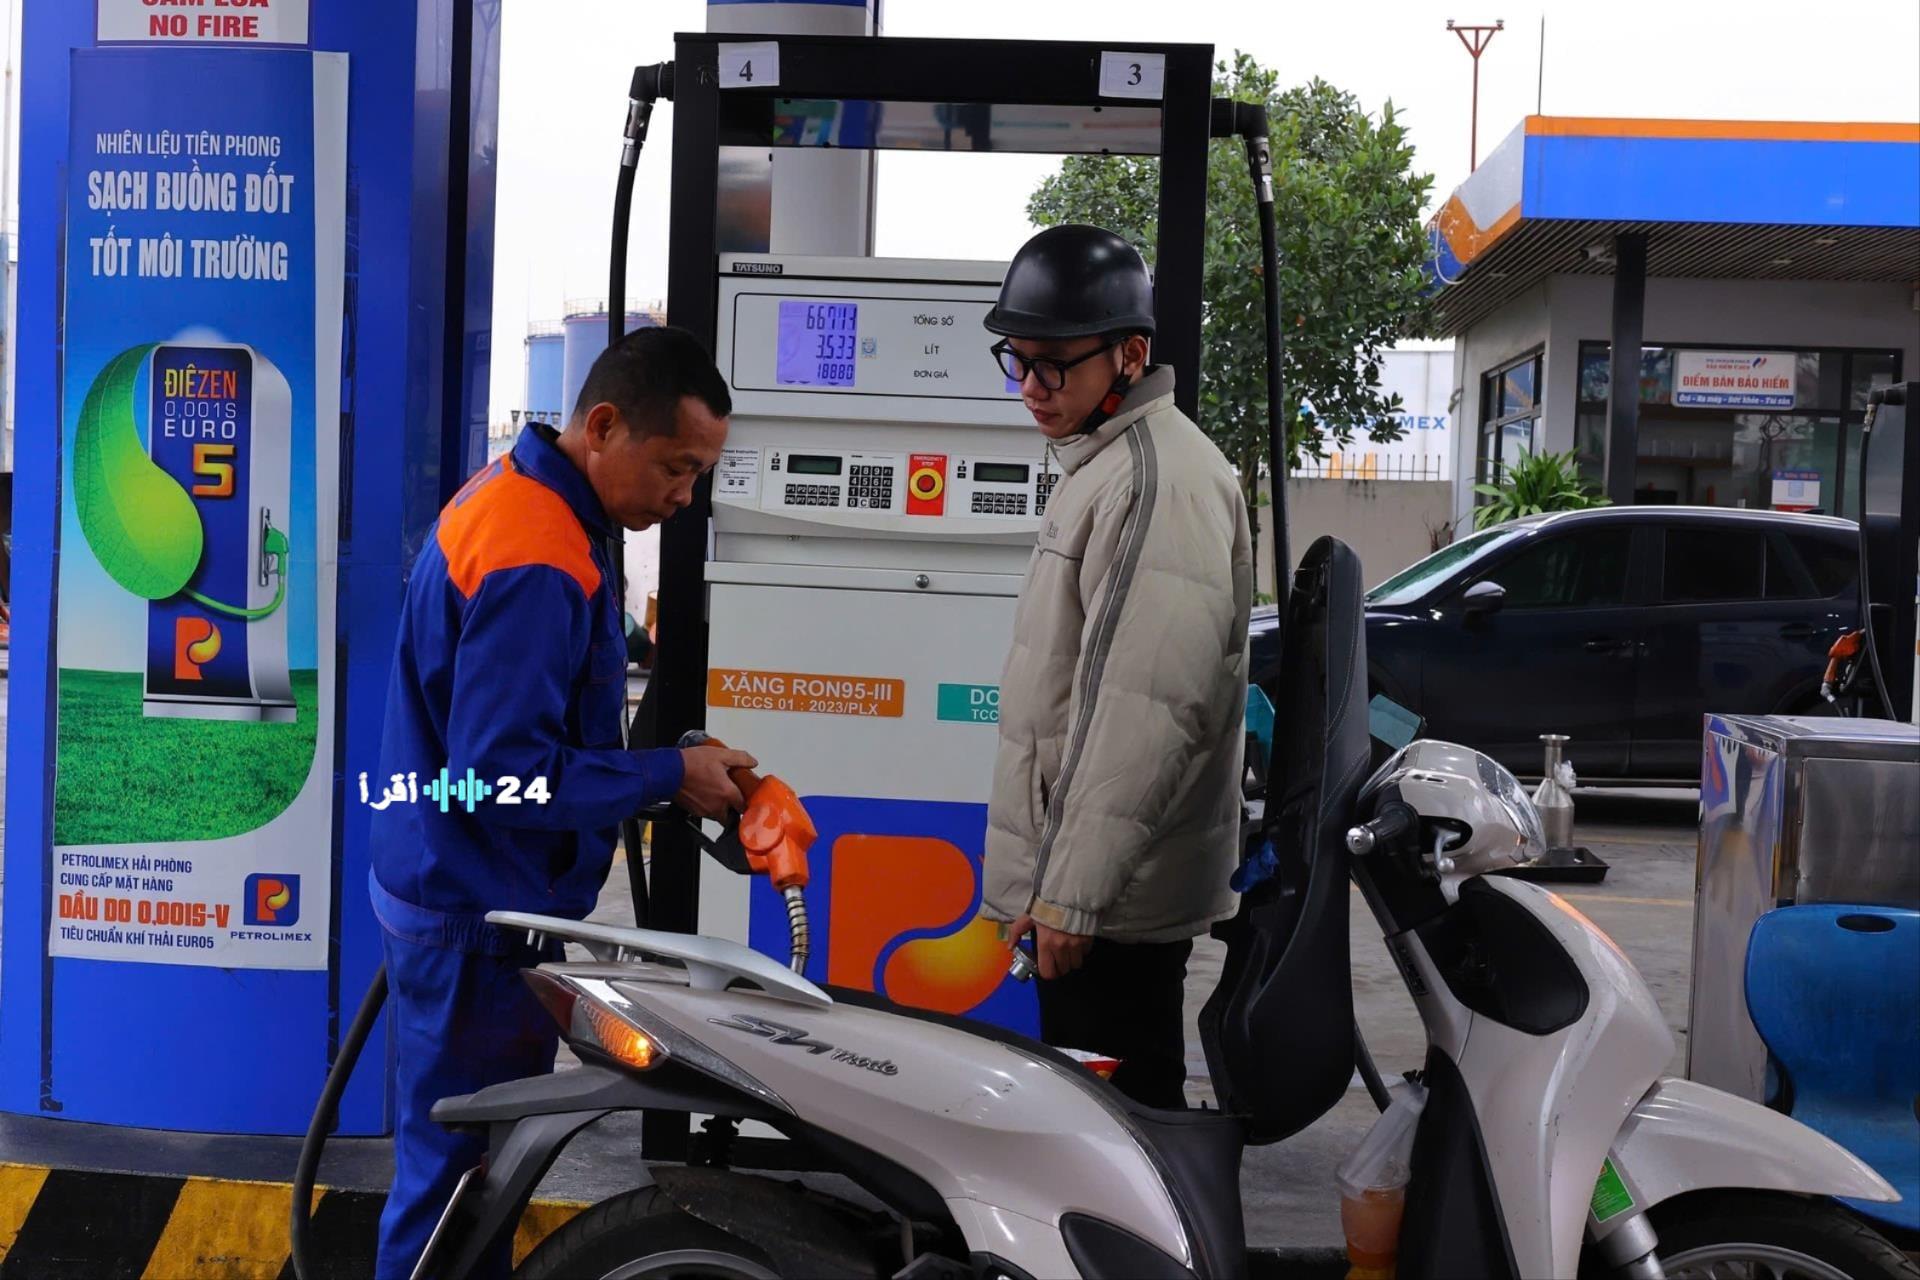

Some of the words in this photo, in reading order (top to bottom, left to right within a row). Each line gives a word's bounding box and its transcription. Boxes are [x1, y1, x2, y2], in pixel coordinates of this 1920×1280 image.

[149, 14, 187, 36] NO
[197, 15, 258, 38] FIRE
[739, 60, 753, 82] 4
[1127, 63, 1141, 86] 3
[96, 130, 142, 154] NHIÊN
[147, 130, 180, 159] LIỆU
[185, 130, 220, 155] TIÊN
[225, 135, 281, 158] PHONG
[88, 170, 148, 217] SẠCH
[156, 159, 236, 212] BUỒNG
[244, 161, 294, 213] ĐỐT
[90, 225, 132, 276] TỐT
[138, 232, 183, 278] MÔI
[191, 233, 288, 281] TRƯỜNG
[735, 263, 780, 273] TATSUNO
[941, 315, 954, 326] SỐ
[924, 344, 940, 355] LÍT
[164, 363, 237, 399] ĐIÊZEN
[817, 363, 854, 380] 18880
[914, 369, 932, 378] ĐƠN
[933, 368, 949, 378] GIÁ
[164, 419, 236, 440] EURO
[192, 443, 235, 496] 5
[720, 672, 785, 695] XĂNG
[792, 677, 892, 701] RON95-III
[970, 688, 1000, 706] DO
[731, 695, 773, 710] TCCS
[778, 698, 794, 711] 01
[809, 699, 878, 716] 2023/PLX
[62, 853, 129, 870] PETROLIMEX
[132, 855, 150, 871] HẢI
[154, 857, 192, 873] PHÒNG
[60, 873, 89, 887] CUNG
[91, 872, 112, 888] CẤP
[115, 874, 139, 892] MẶT
[142, 876, 173, 892] HÀNG
[59, 890, 98, 920] DẦU
[104, 898, 131, 922] DO
[60, 926, 84, 940] TIÊU
[86, 925, 123, 944] CHUẨN
[126, 931, 145, 946] KHÍ
[148, 930, 173, 947] THẢI
[231, 931, 312, 942] PETROLIMEX
